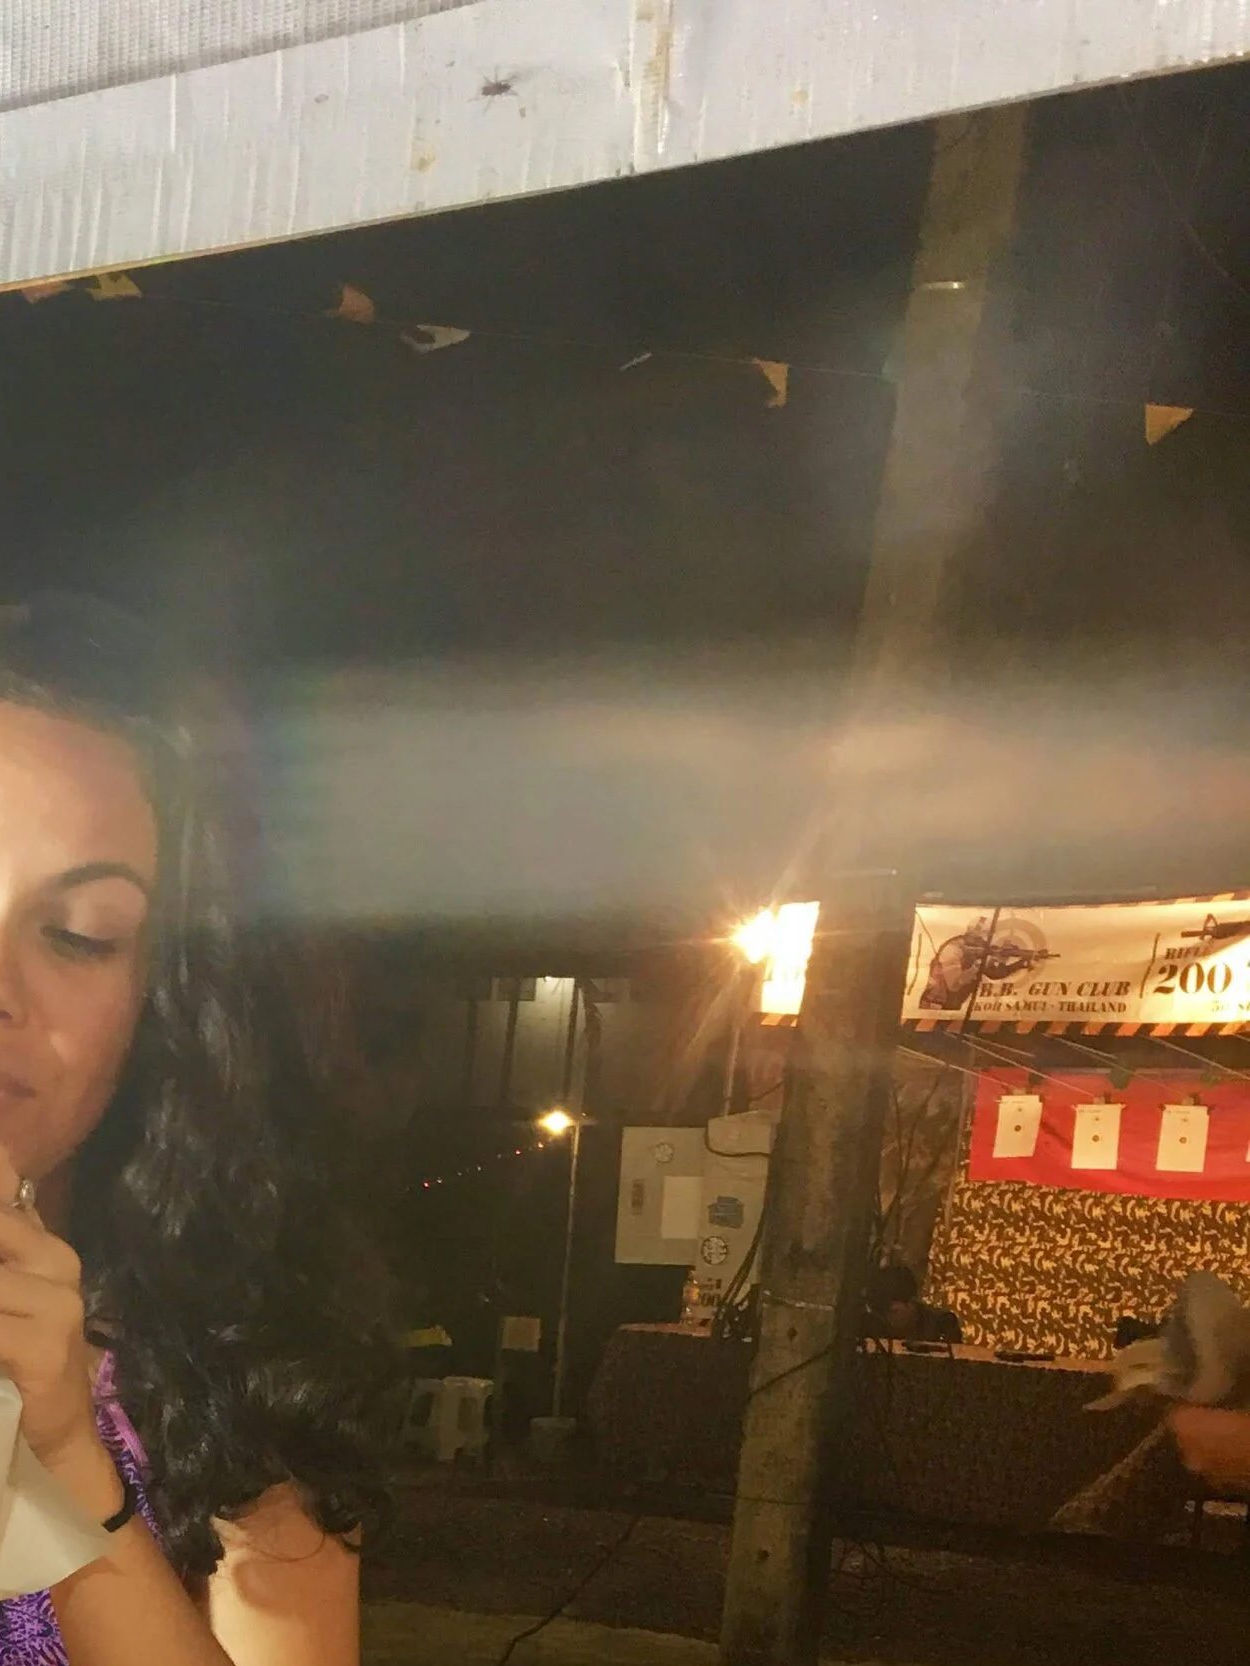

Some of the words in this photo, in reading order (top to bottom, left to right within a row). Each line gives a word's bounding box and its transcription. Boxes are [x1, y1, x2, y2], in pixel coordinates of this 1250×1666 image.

[1153, 961, 1233, 995] 200
[979, 981, 1018, 998] B.B.
[1028, 980, 1073, 997] GUN
[1076, 980, 1132, 997] CLUB
[1005, 1000, 1046, 1013] SAMUI
[1058, 1001, 1127, 1013] THAILAND
